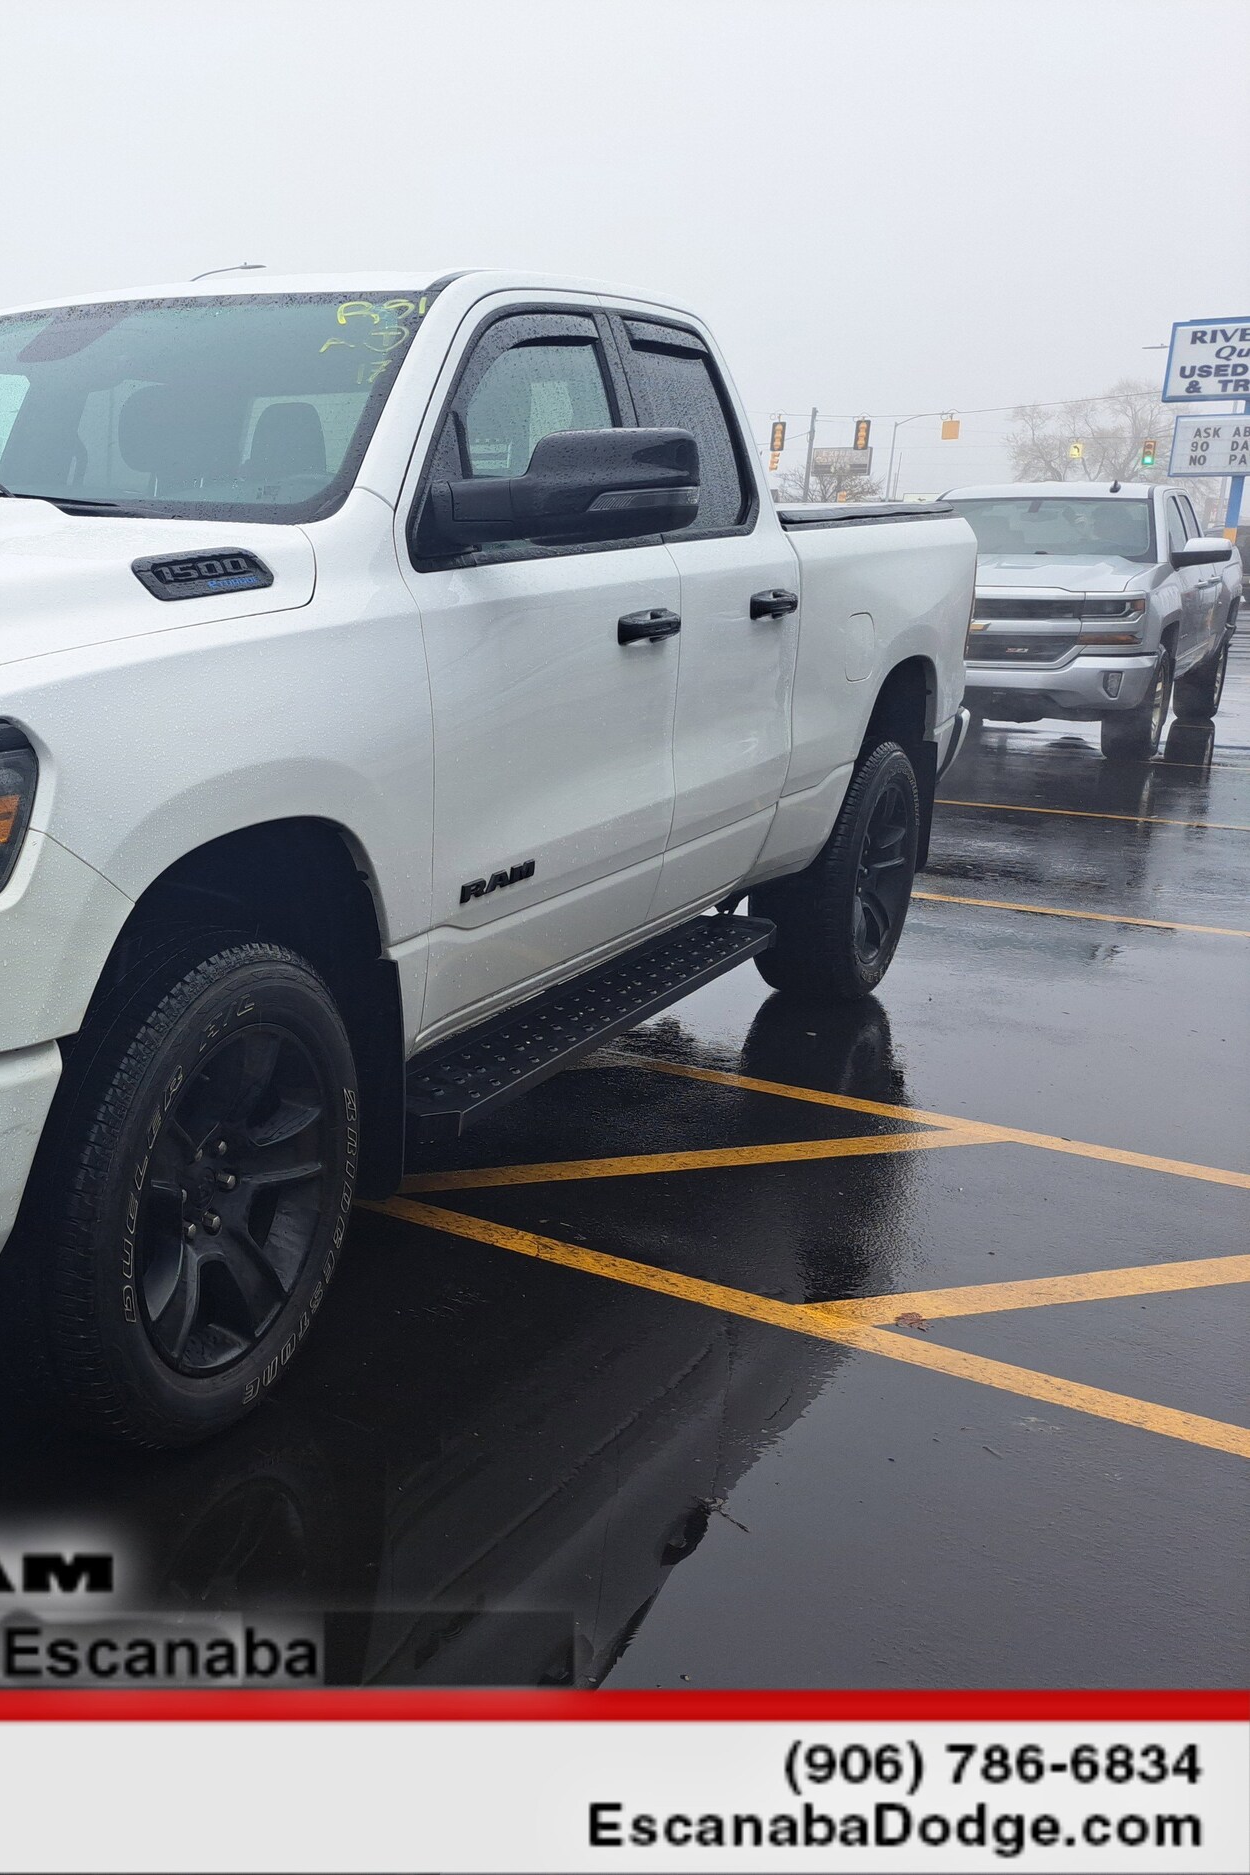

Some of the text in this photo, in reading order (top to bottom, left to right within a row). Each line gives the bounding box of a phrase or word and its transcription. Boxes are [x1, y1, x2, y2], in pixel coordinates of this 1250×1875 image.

[1179, 363, 1249, 379] USED
[1185, 380, 1202, 394] &
[1193, 427, 1222, 439] ASK
[1190, 441, 1210, 452] 90
[1188, 454, 1207, 466] NO
[154, 556, 250, 584] 1500
[459, 858, 535, 904] RAM
[241, 1088, 361, 1406] BRIDGESTONE
